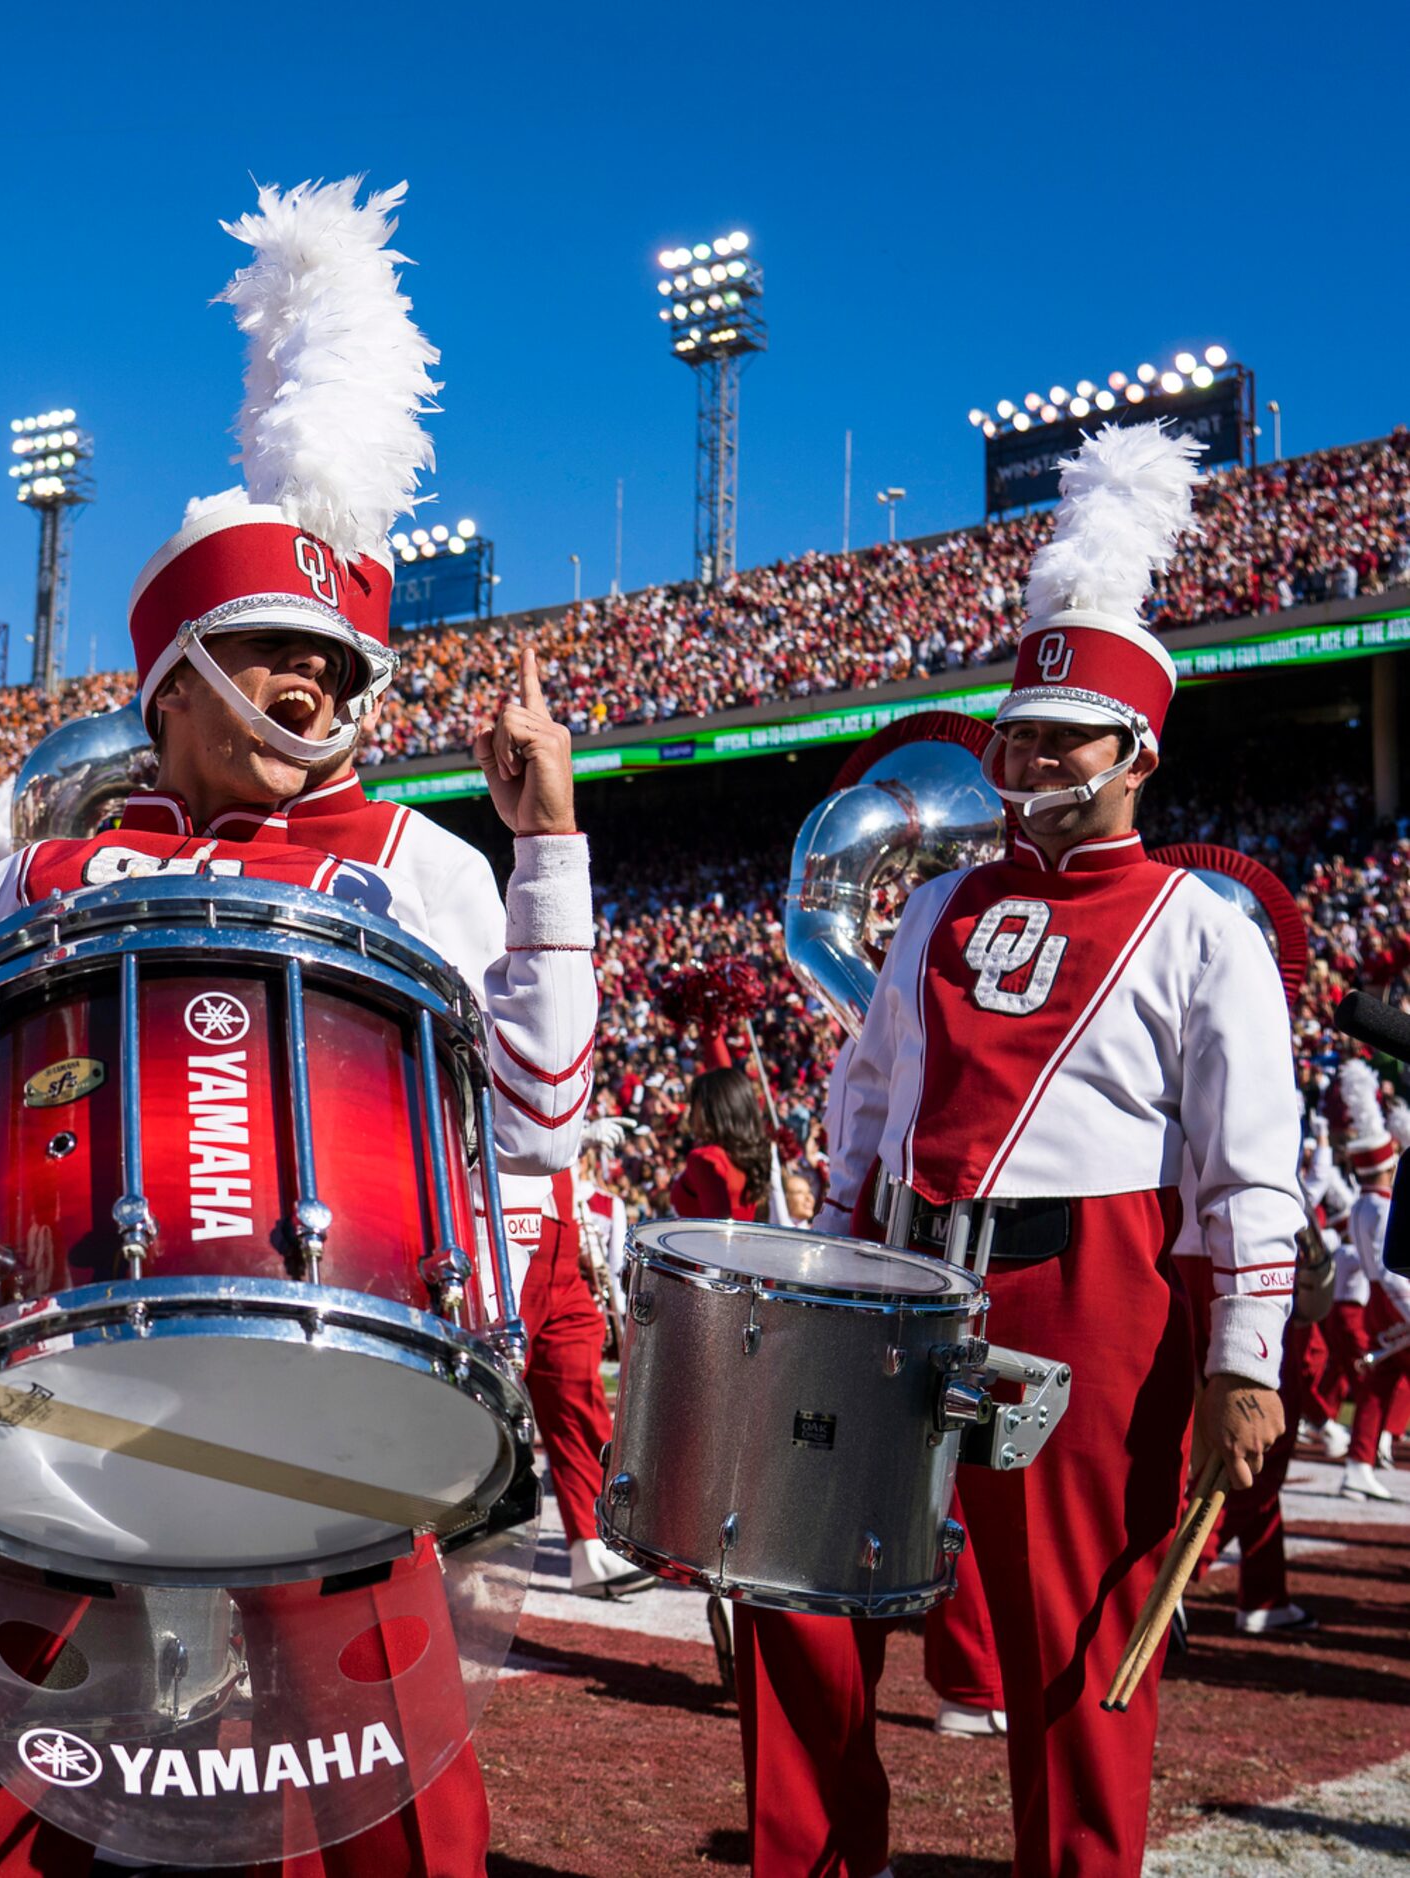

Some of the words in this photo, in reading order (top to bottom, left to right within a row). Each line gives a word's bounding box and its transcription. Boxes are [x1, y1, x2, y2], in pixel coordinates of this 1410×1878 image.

[292, 534, 339, 609] OU
[393, 575, 436, 603] T&T
[1037, 632, 1075, 682] OU
[963, 899, 1070, 1017] OU
[188, 1050, 254, 1241] YAMAHA
[1236, 1394, 1266, 1422] 14
[110, 1721, 404, 1797] YAMAHA
